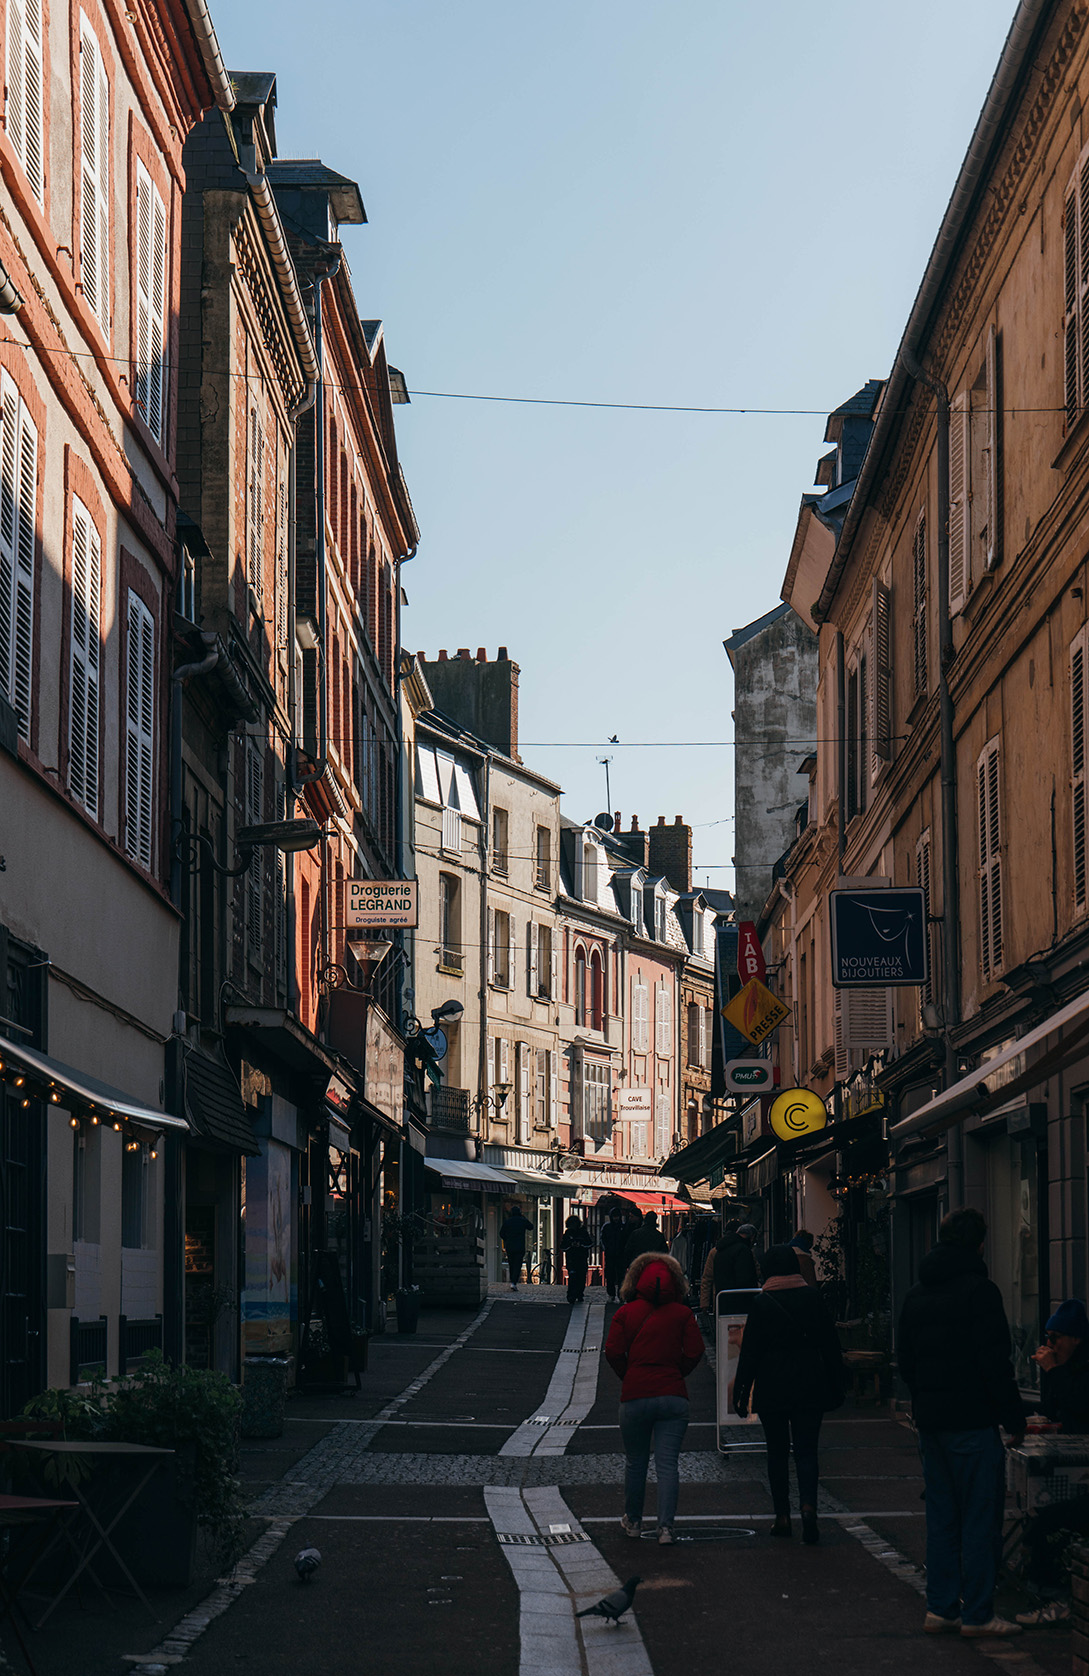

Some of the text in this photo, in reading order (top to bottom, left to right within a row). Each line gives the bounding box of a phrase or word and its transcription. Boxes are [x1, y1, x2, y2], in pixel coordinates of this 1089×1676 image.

[352, 884, 410, 898] Droguerie
[351, 900, 411, 910] LEGRAND
[744, 932, 758, 978] TAB
[841, 956, 902, 967] NOUVEAUX
[841, 966, 904, 978] BIJOUTIERS
[750, 1005, 784, 1041] PRESSE
[734, 1072, 752, 1080] PMU
[600, 1172, 617, 1185] CAVE
